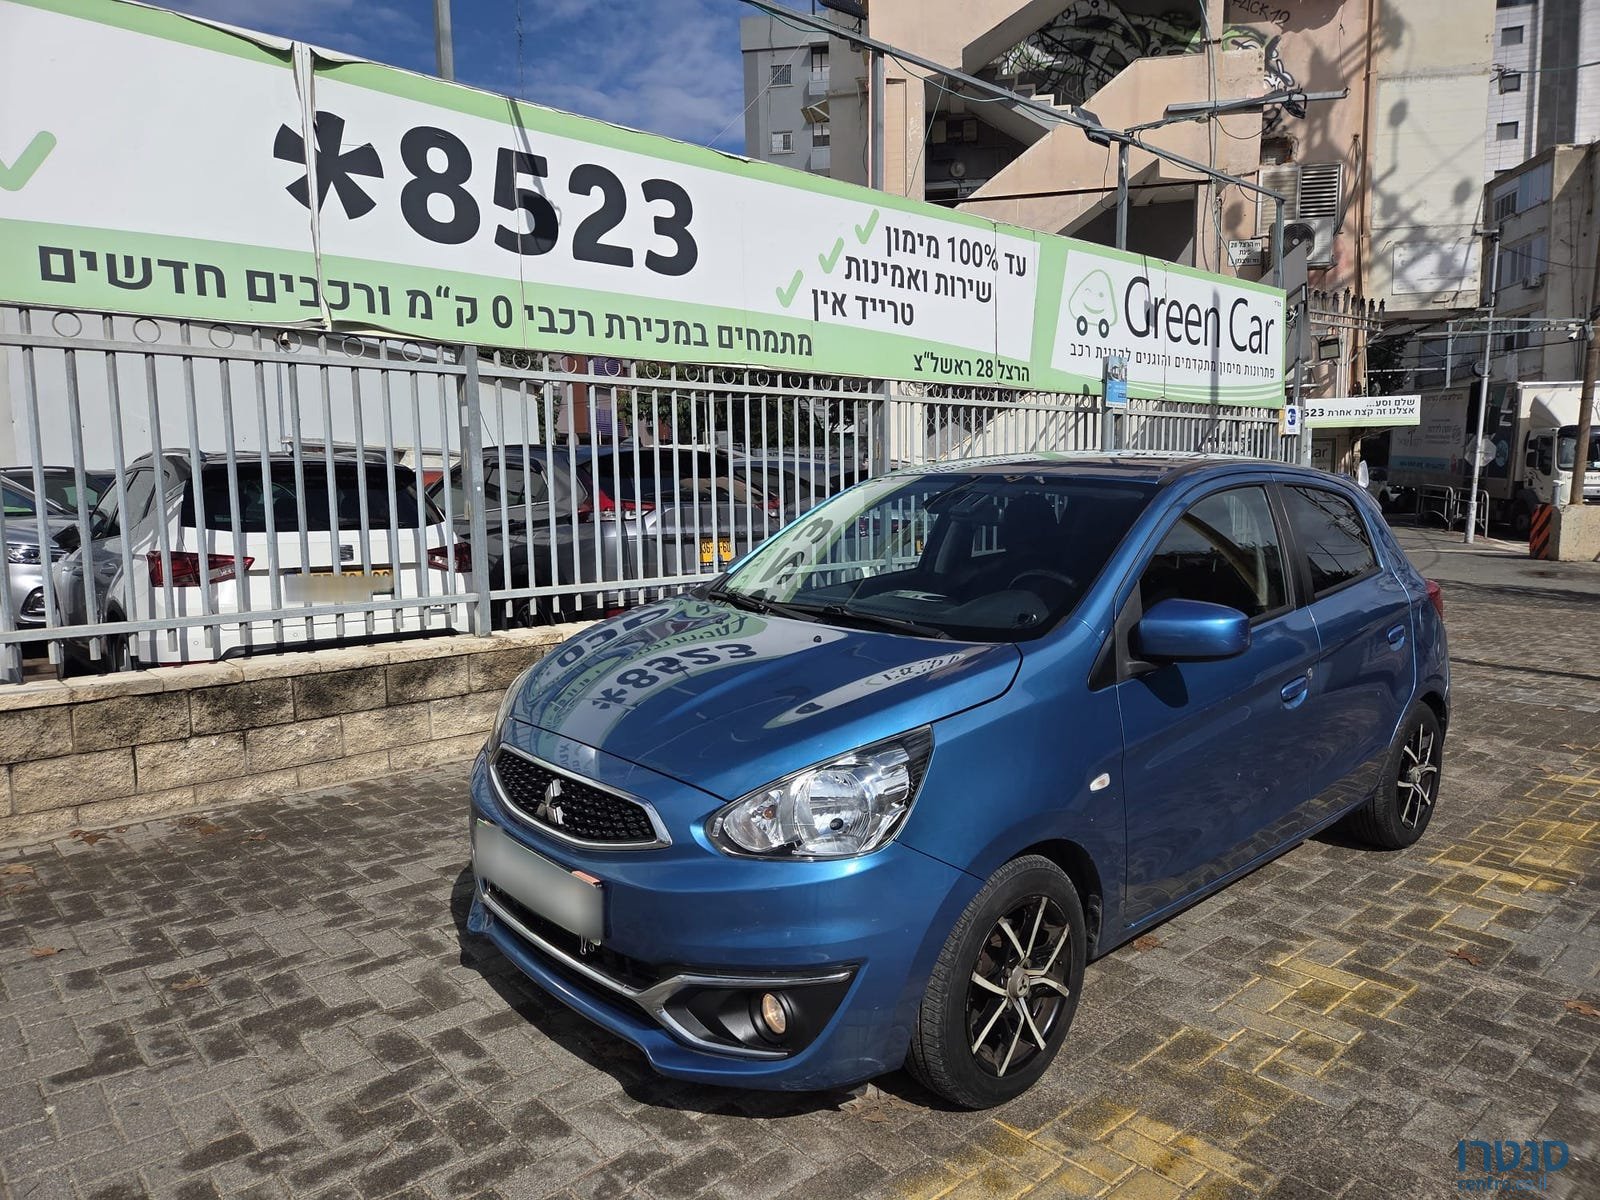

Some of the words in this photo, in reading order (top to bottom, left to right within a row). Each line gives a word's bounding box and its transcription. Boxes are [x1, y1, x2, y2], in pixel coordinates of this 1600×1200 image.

[885, 226, 940, 259] מימון
[948, 237, 999, 271] 100%
[38, 245, 227, 299] חדשים
[844, 255, 928, 292] ואמינות
[1004, 252, 1027, 277] עד
[245, 269, 391, 316] ורכבים
[935, 272, 992, 303] שירות
[492, 295, 513, 329] 0
[811, 288, 847, 321] אין
[855, 295, 914, 326] טרייד
[1124, 276, 1221, 348] Green
[1229, 298, 1275, 355] Car
[523, 304, 595, 337] רכבי
[605, 313, 709, 347] במכירת
[717, 325, 813, 357] מתמחים
[1070, 343, 1091, 358] רכב
[976, 359, 993, 378] 28
[997, 360, 1030, 382] הרצל
[1136, 351, 1171, 367] והוגנים
[1175, 356, 1216, 374] מתקדמים
[1219, 361, 1241, 376] מימון
[1243, 365, 1275, 379] פתרונות
[1327, 409, 1351, 417] אחרת
[1354, 408, 1374, 417] קצת
[1389, 407, 1415, 415] אצלנו
[1395, 399, 1415, 407] שלם
[1312, 448, 1328, 458] ar
